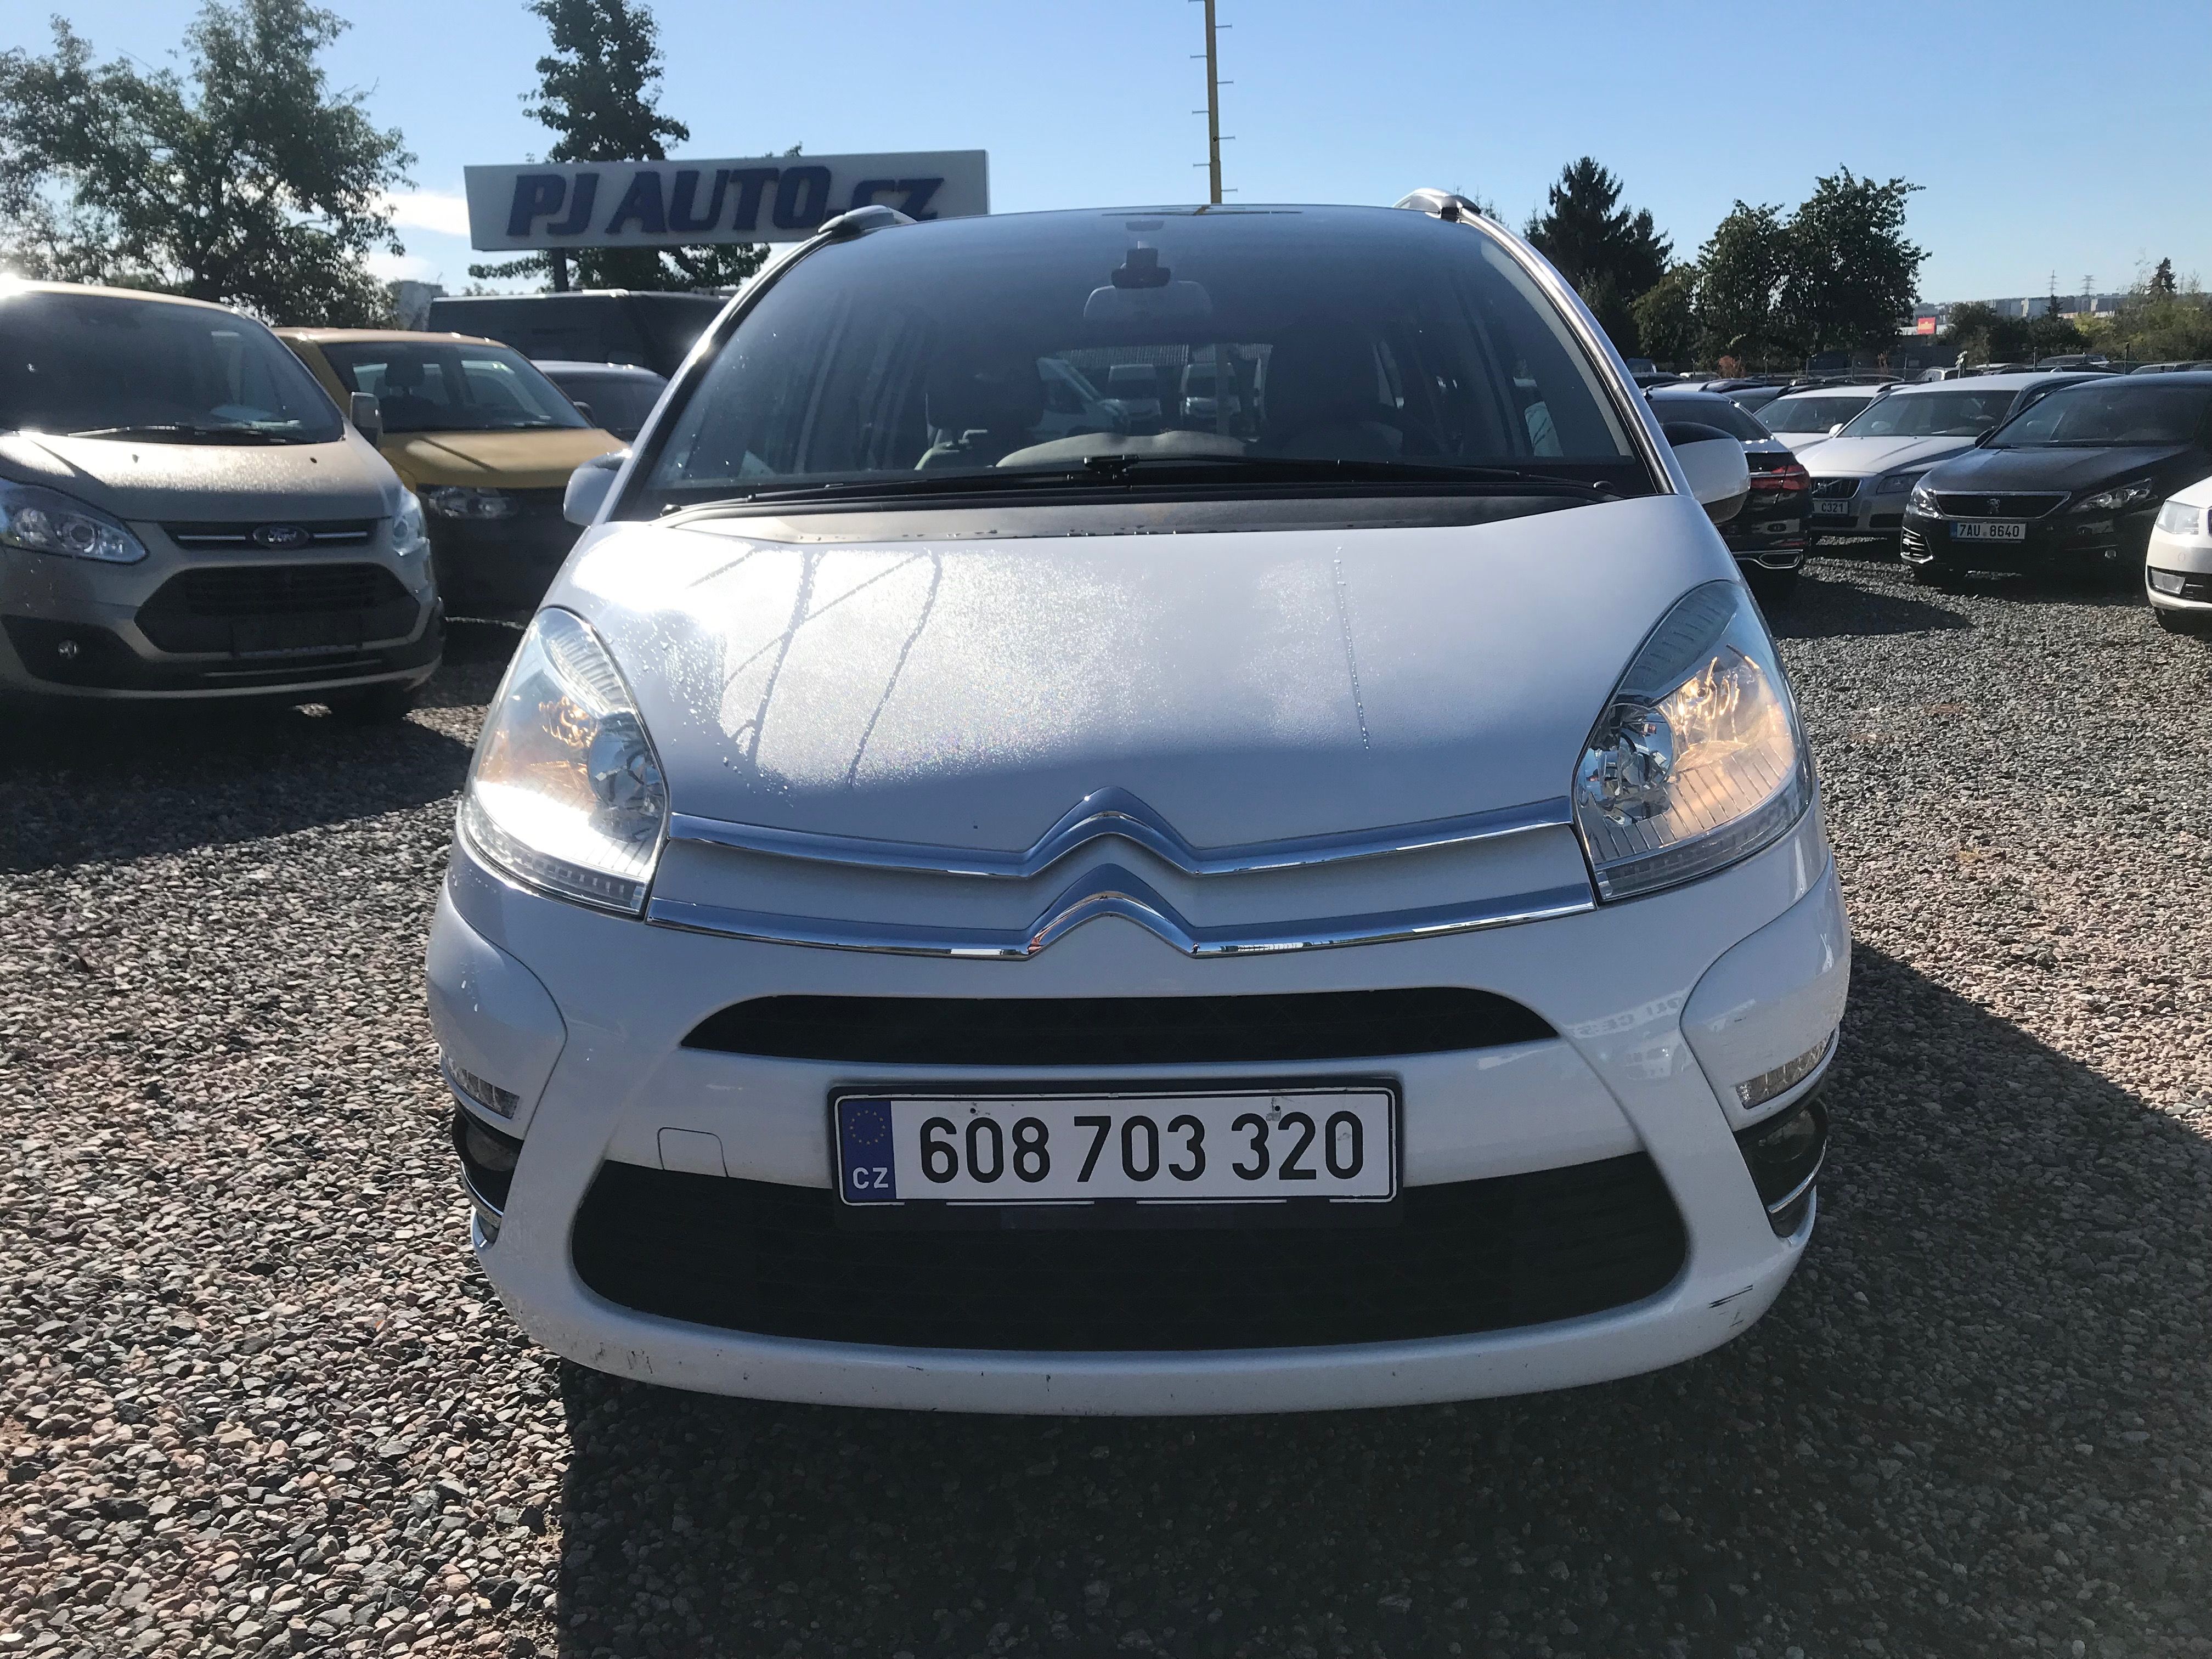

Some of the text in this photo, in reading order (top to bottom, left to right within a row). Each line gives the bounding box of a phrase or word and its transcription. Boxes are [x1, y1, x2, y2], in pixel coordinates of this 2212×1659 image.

[506, 172, 600, 236] PJ
[1957, 524, 2019, 537] 7AU 8640
[919, 1111, 1364, 1183] 608 703 320
[853, 1167, 889, 1190] CZ
